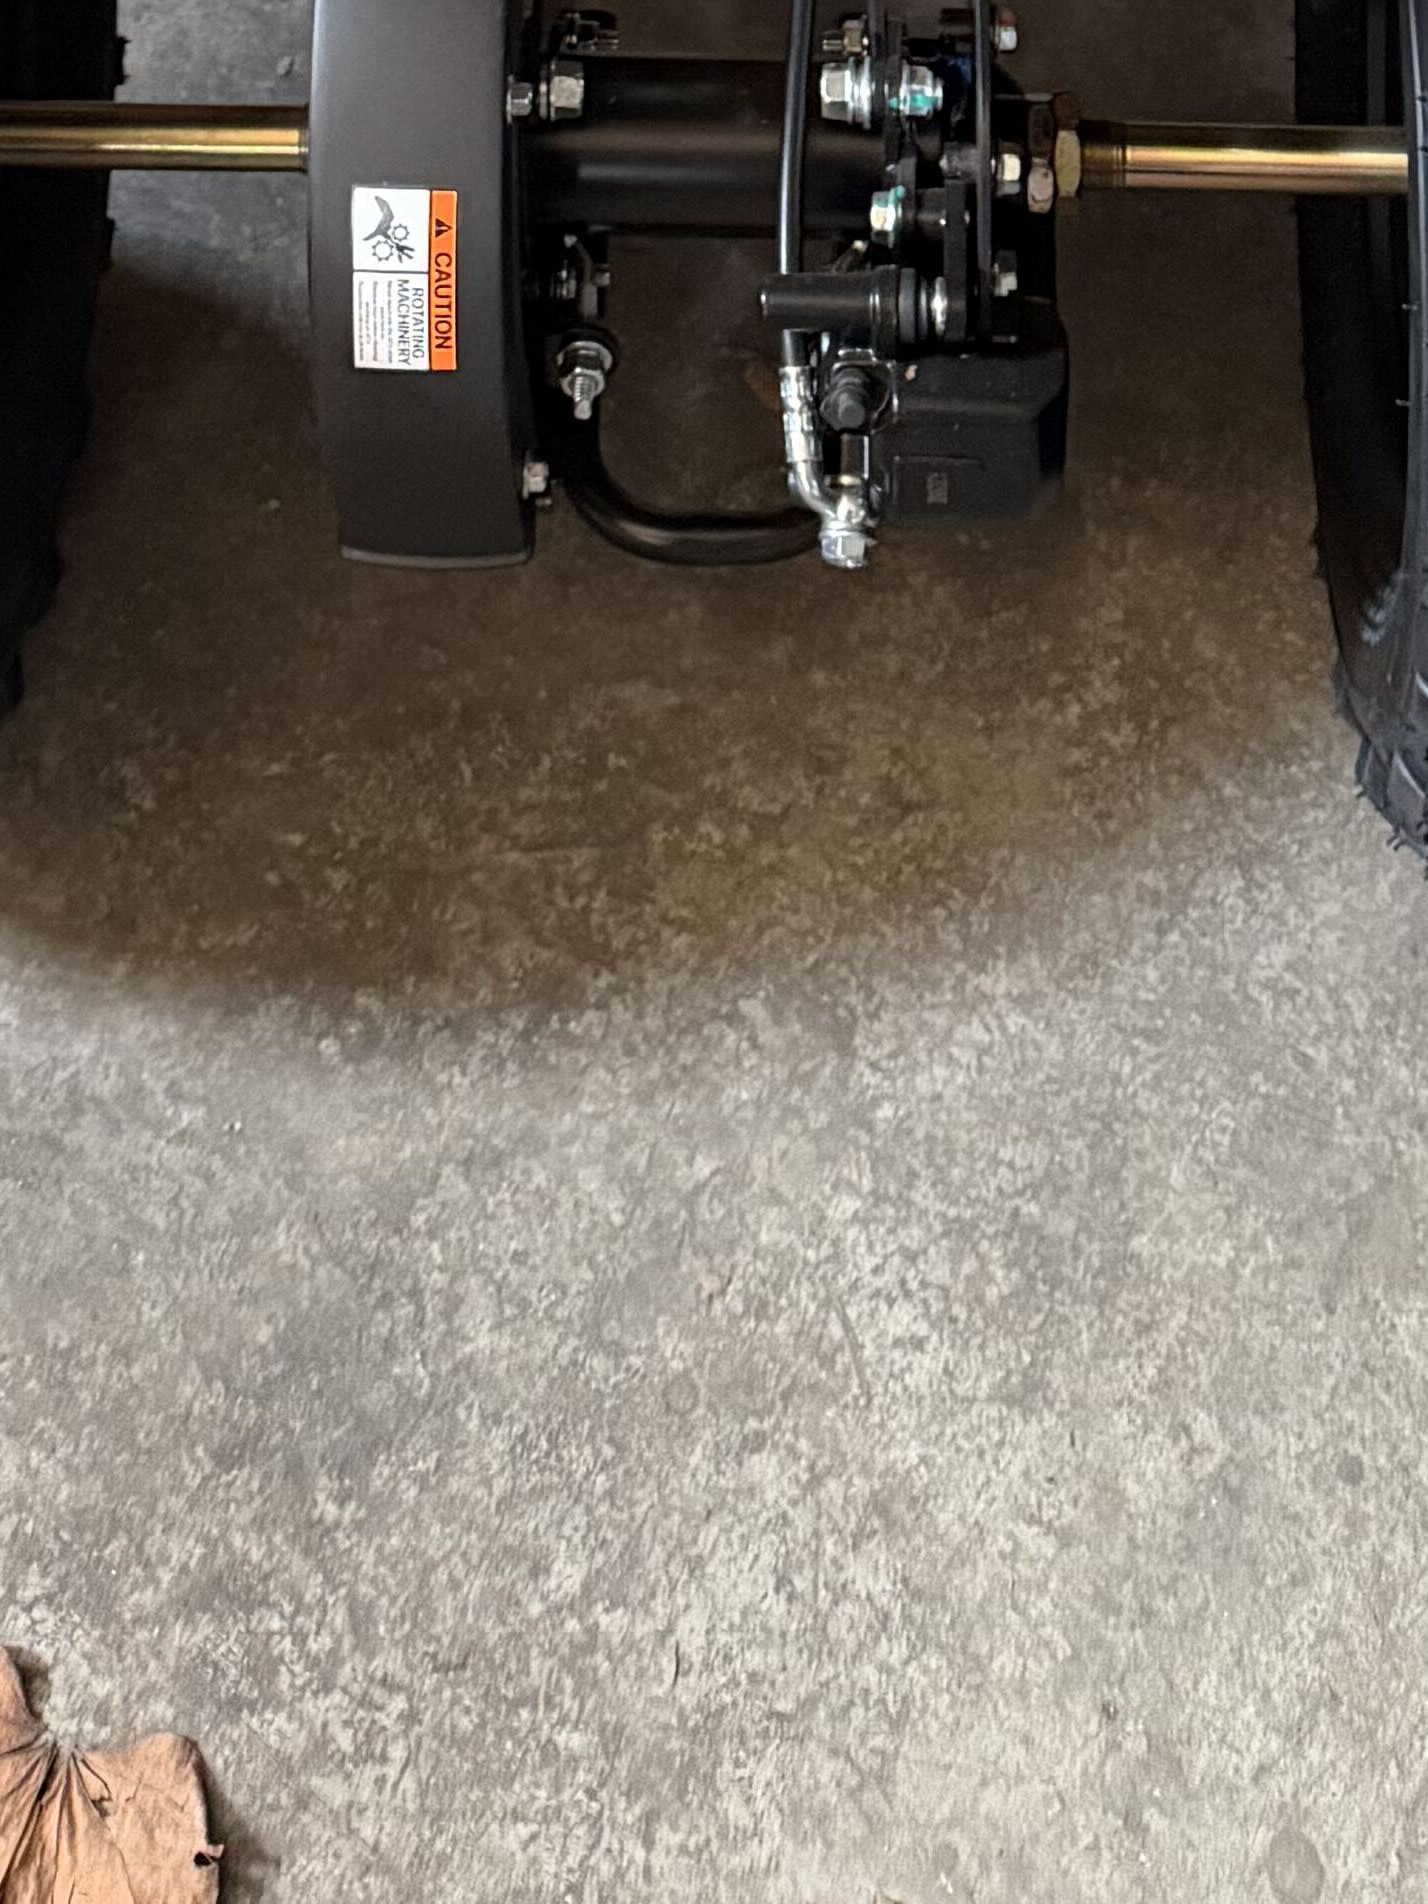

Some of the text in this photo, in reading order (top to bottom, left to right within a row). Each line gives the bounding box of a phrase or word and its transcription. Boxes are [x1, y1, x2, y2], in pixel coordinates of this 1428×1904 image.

[396, 279, 410, 365] MACHINERY
[411, 287, 424, 358] ROTATING
[434, 252, 452, 349] CAUTION
